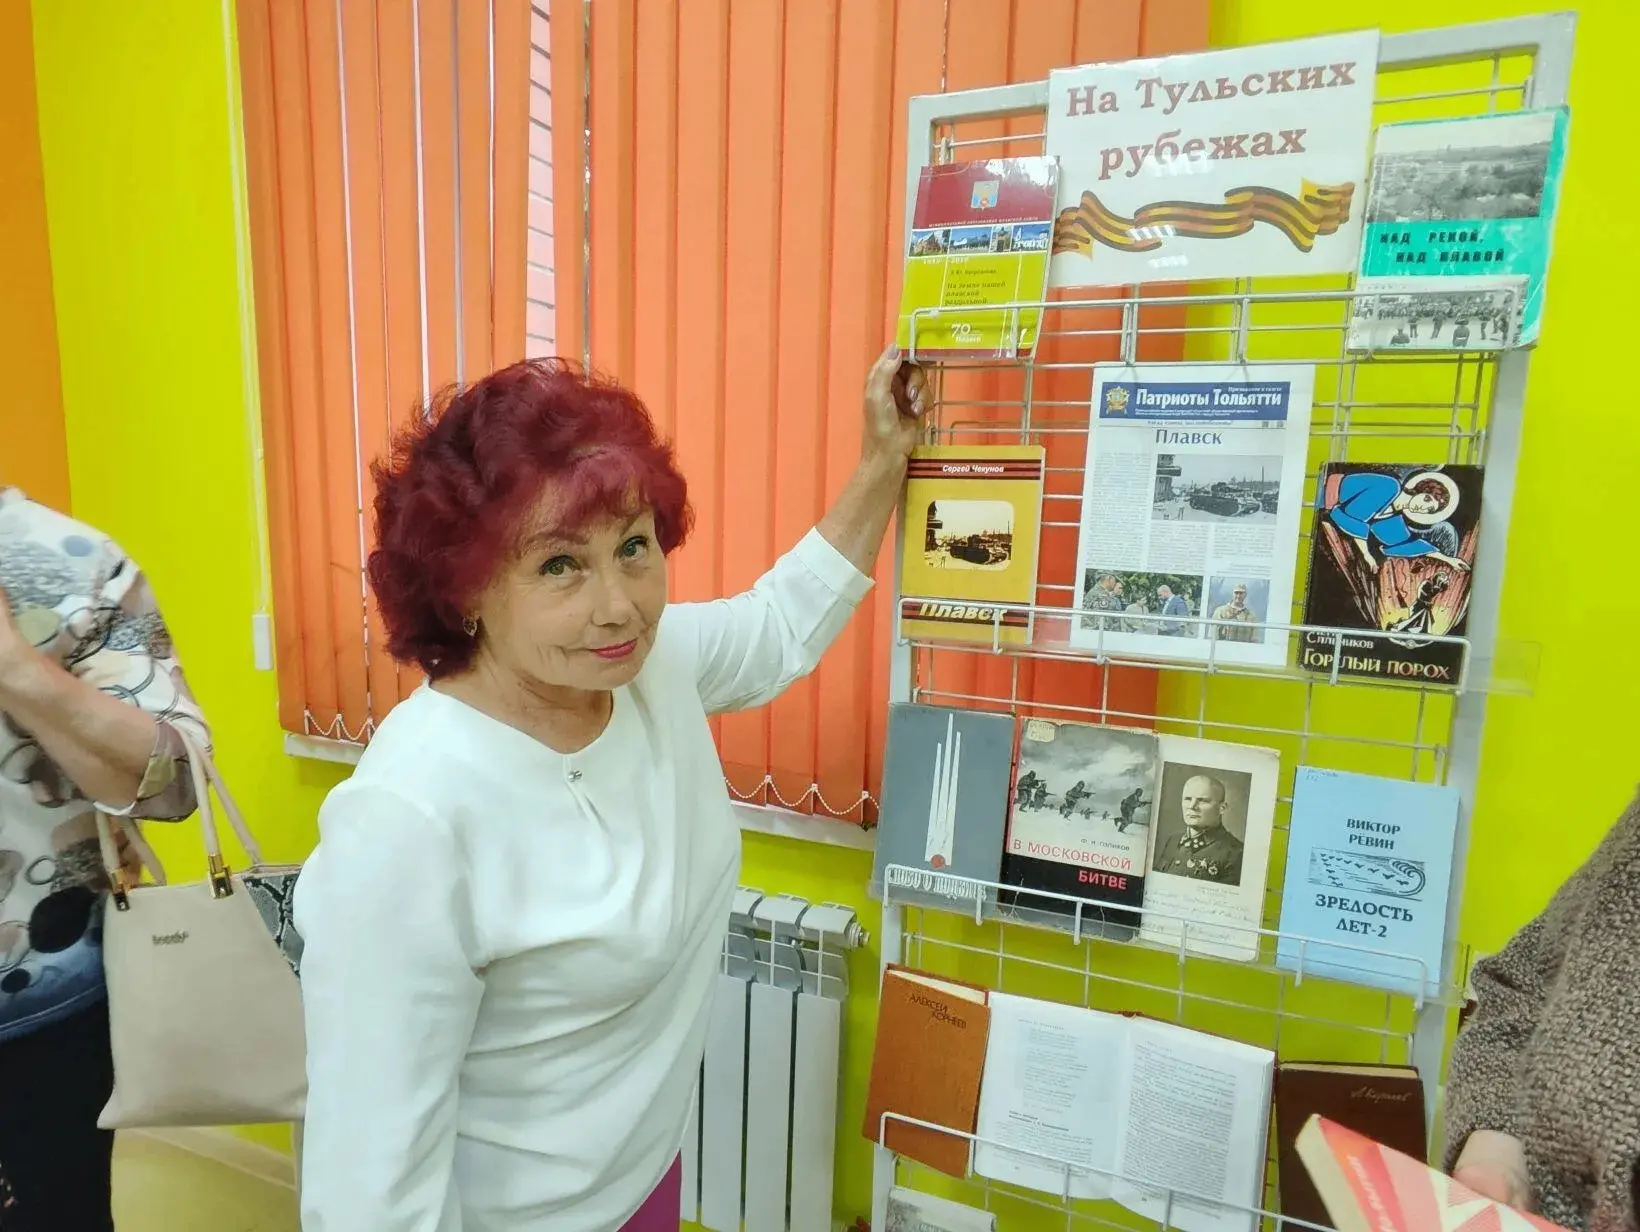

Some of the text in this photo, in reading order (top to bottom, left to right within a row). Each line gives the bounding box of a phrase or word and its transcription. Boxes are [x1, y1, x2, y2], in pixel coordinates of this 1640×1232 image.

[1066, 61, 1356, 117] На Тульских
[1098, 128, 1307, 180] рубежах
[1380, 231, 1411, 245] НАД
[1395, 248, 1504, 264] НАД ПЛАВОЙ
[1135, 388, 1282, 409] Патриоты Тольятти
[1155, 429, 1223, 445] Плавск
[942, 464, 971, 474] Сергей
[1346, 818, 1401, 835] ВИКТОР
[1013, 838, 1131, 871] В МОСКОВСКОЙ
[1078, 869, 1128, 891] БИТВЕ
[1315, 893, 1414, 922] ЗРЕЛОСТЬ
[1336, 918, 1388, 938] ЛЕТ-2
